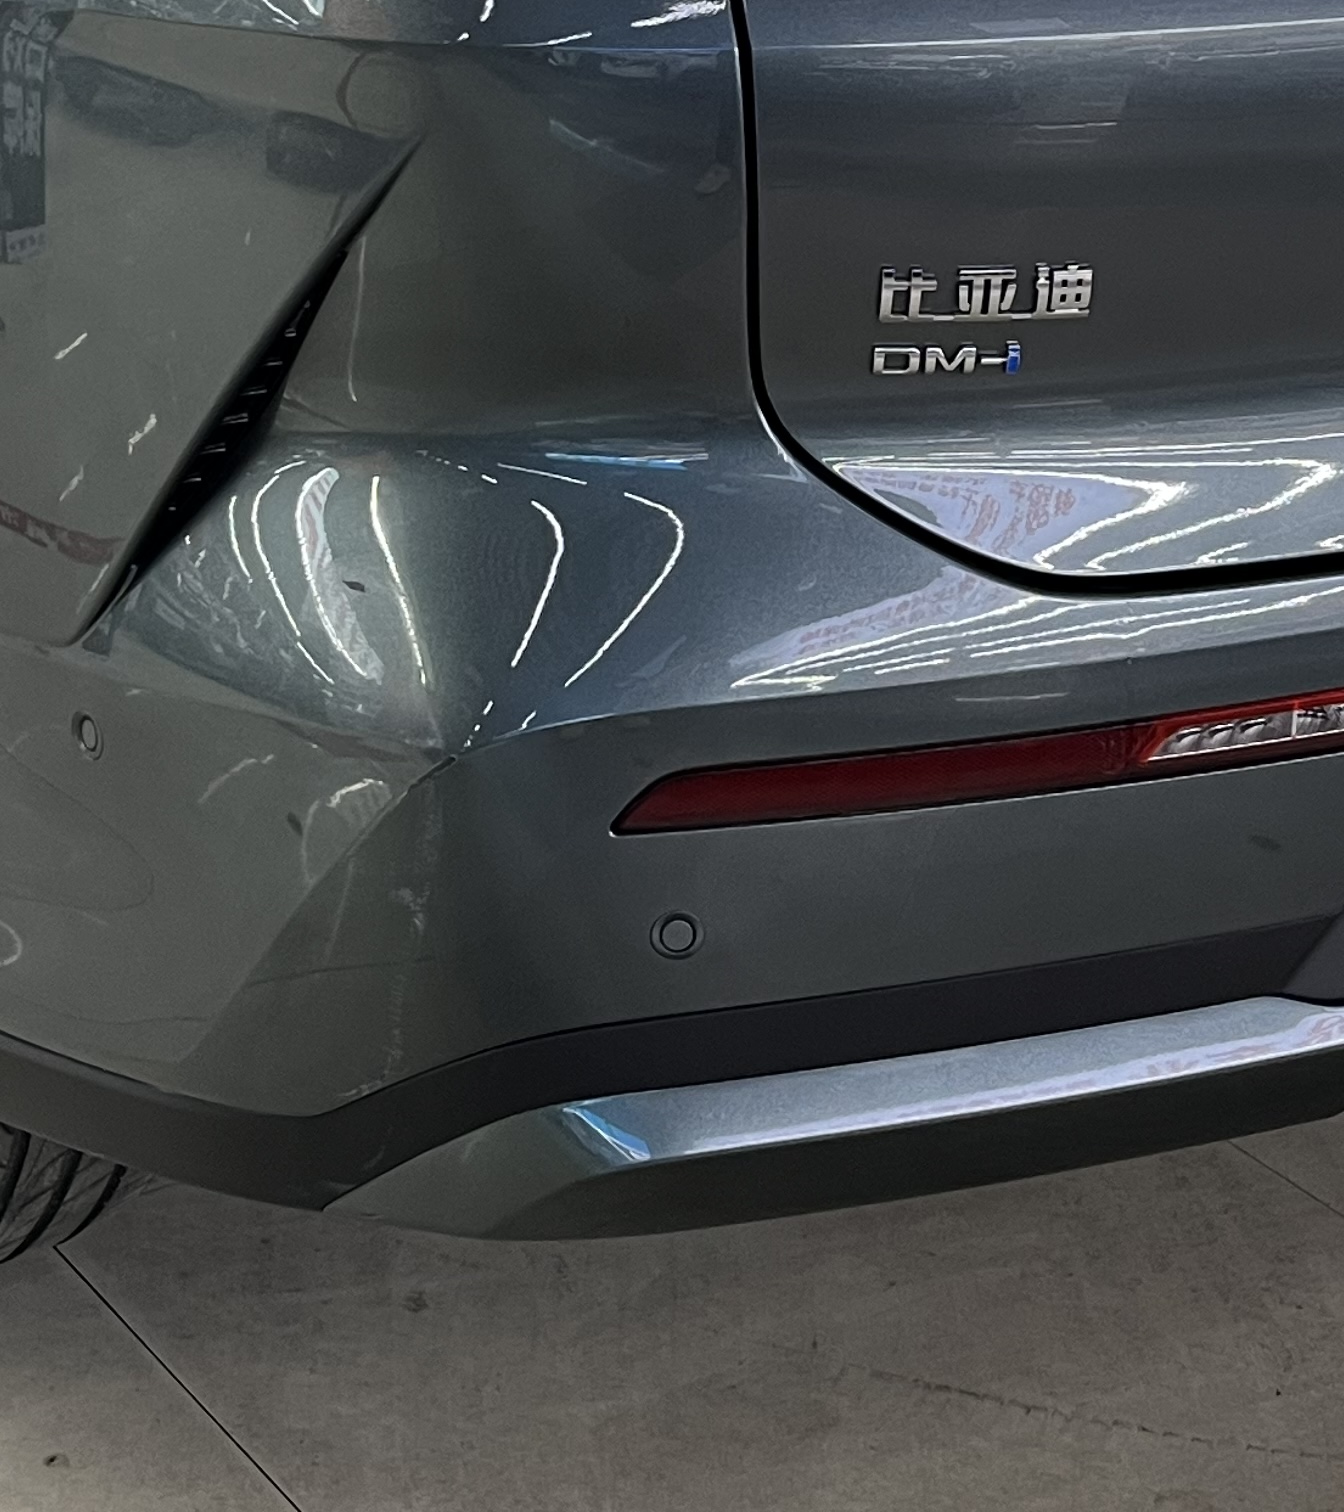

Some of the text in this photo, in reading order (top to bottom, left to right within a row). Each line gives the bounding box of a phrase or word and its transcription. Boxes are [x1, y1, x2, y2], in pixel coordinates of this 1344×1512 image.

[879, 261, 1093, 323] 比亚迪
[872, 340, 1021, 375] DM-i
